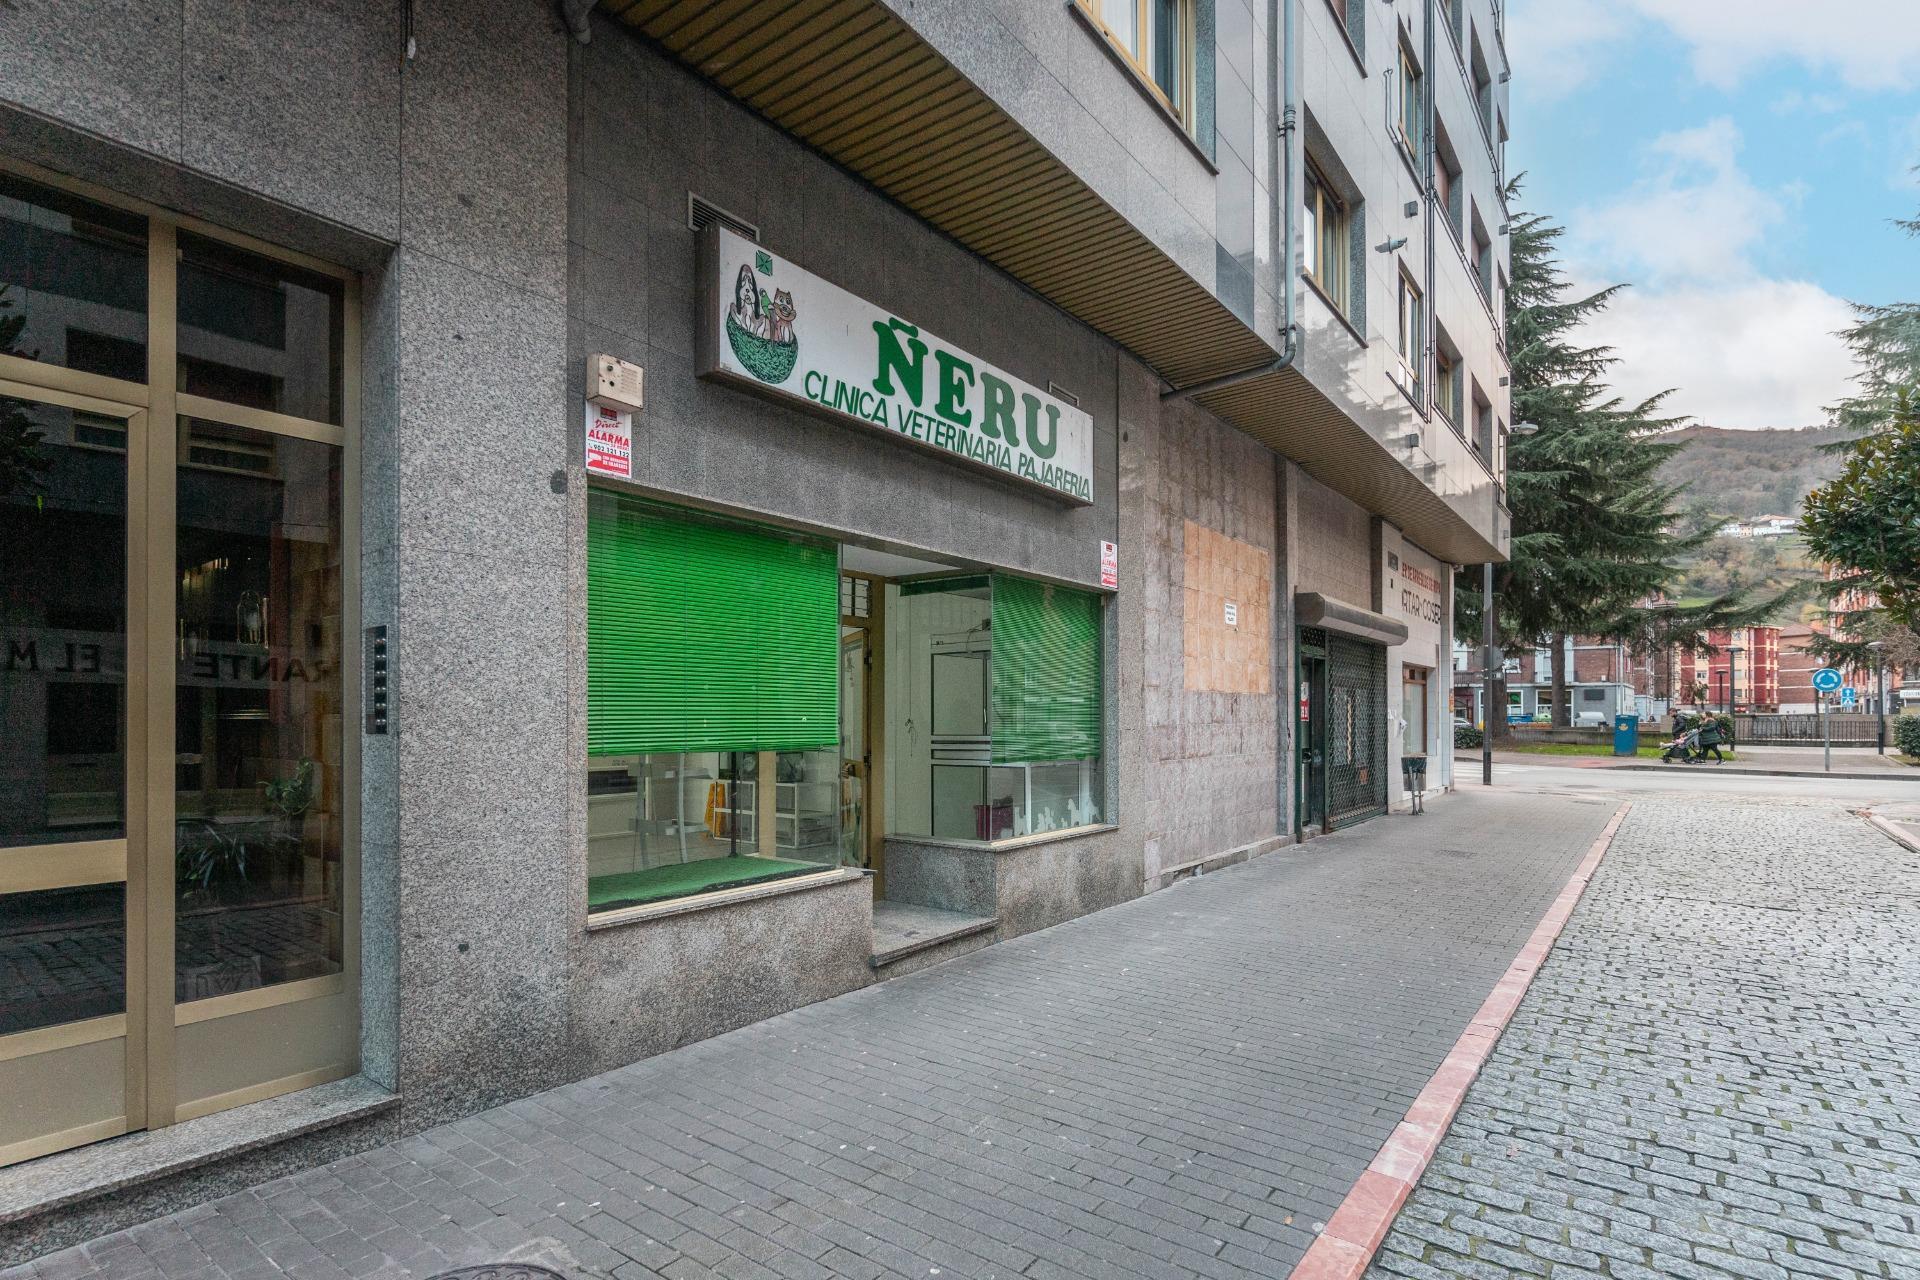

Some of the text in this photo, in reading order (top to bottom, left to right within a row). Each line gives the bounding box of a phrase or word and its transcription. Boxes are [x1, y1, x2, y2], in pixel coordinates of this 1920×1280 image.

[588, 429, 630, 447] ALARMA
[804, 370, 1091, 500] CLINICA VETERINARIA PAJARERIA
[872, 317, 1061, 459] ÑERU
